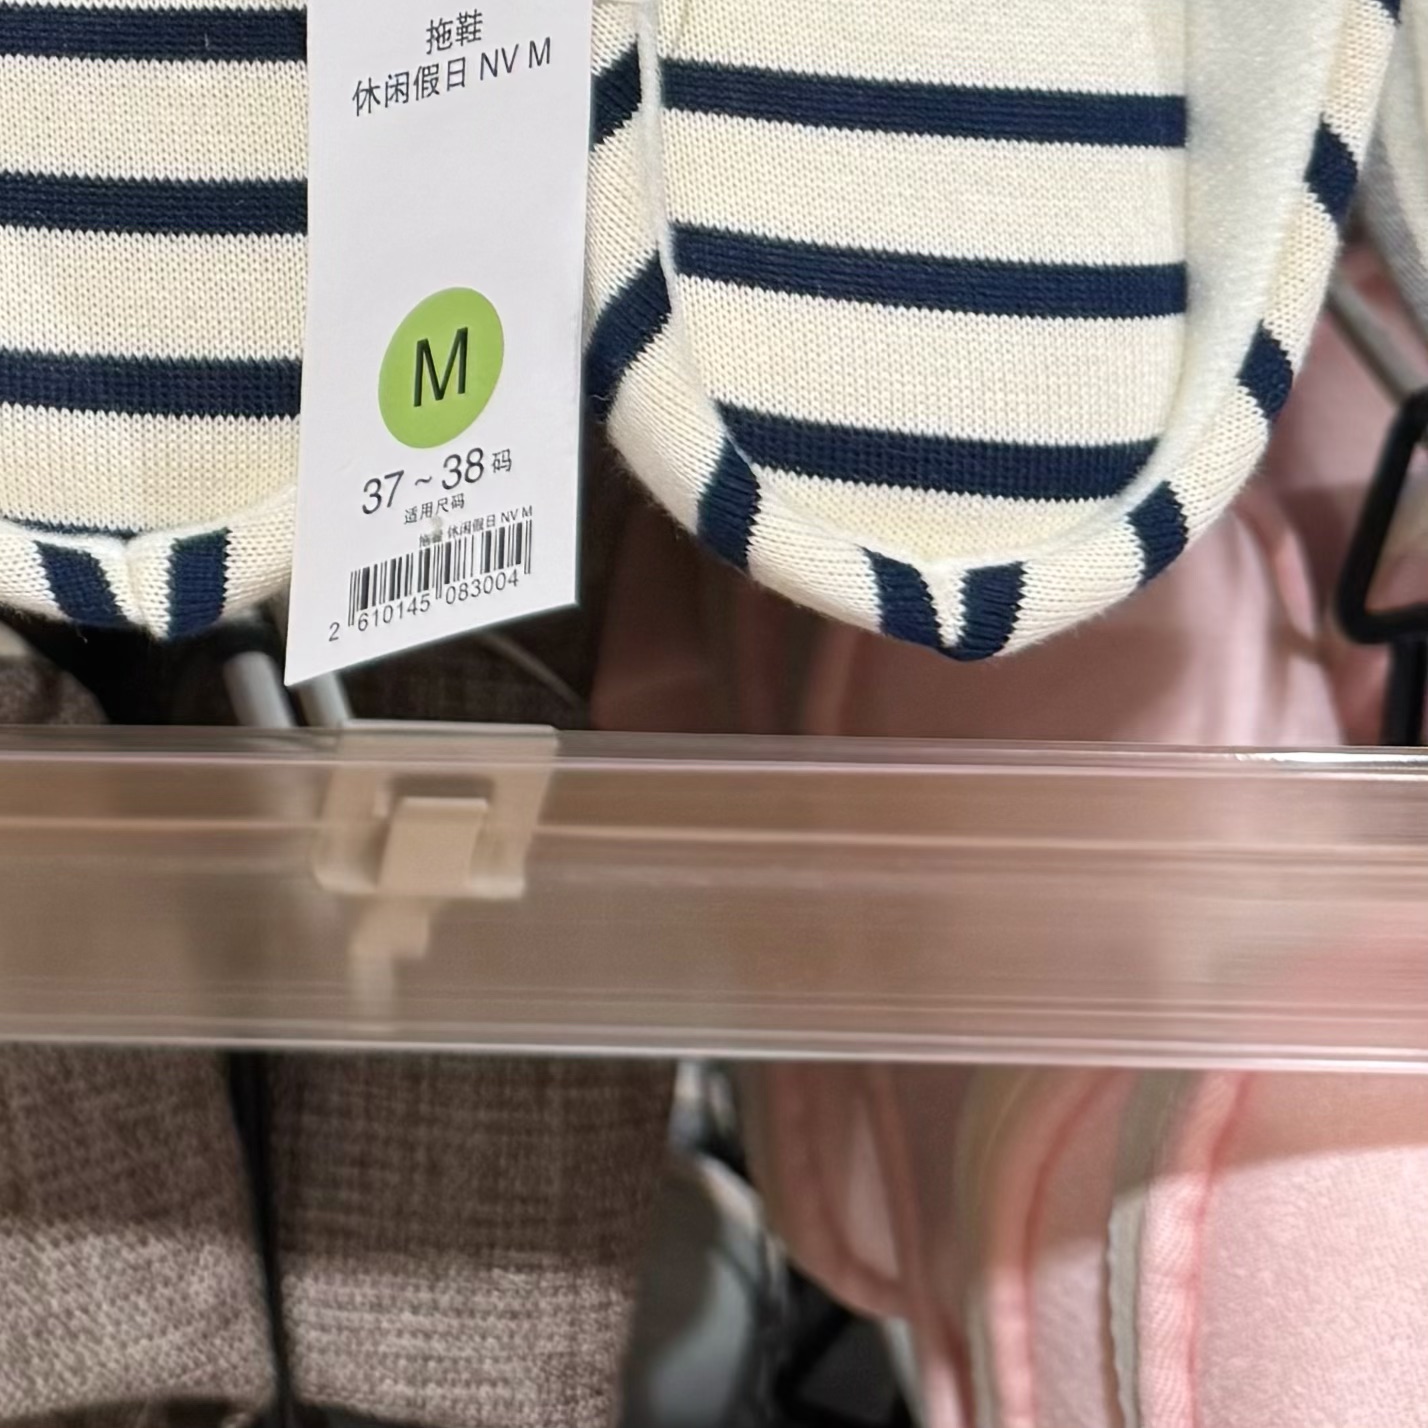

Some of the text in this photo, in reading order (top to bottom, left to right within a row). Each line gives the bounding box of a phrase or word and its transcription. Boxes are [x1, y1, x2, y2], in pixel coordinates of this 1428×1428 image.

[425, 8, 483, 55] 拖鞋
[352, 36, 551, 117] 休闲假日 NV M
[412, 326, 469, 408] M
[403, 493, 466, 525] 适用尺码
[328, 569, 519, 642] 2 610145 083004
